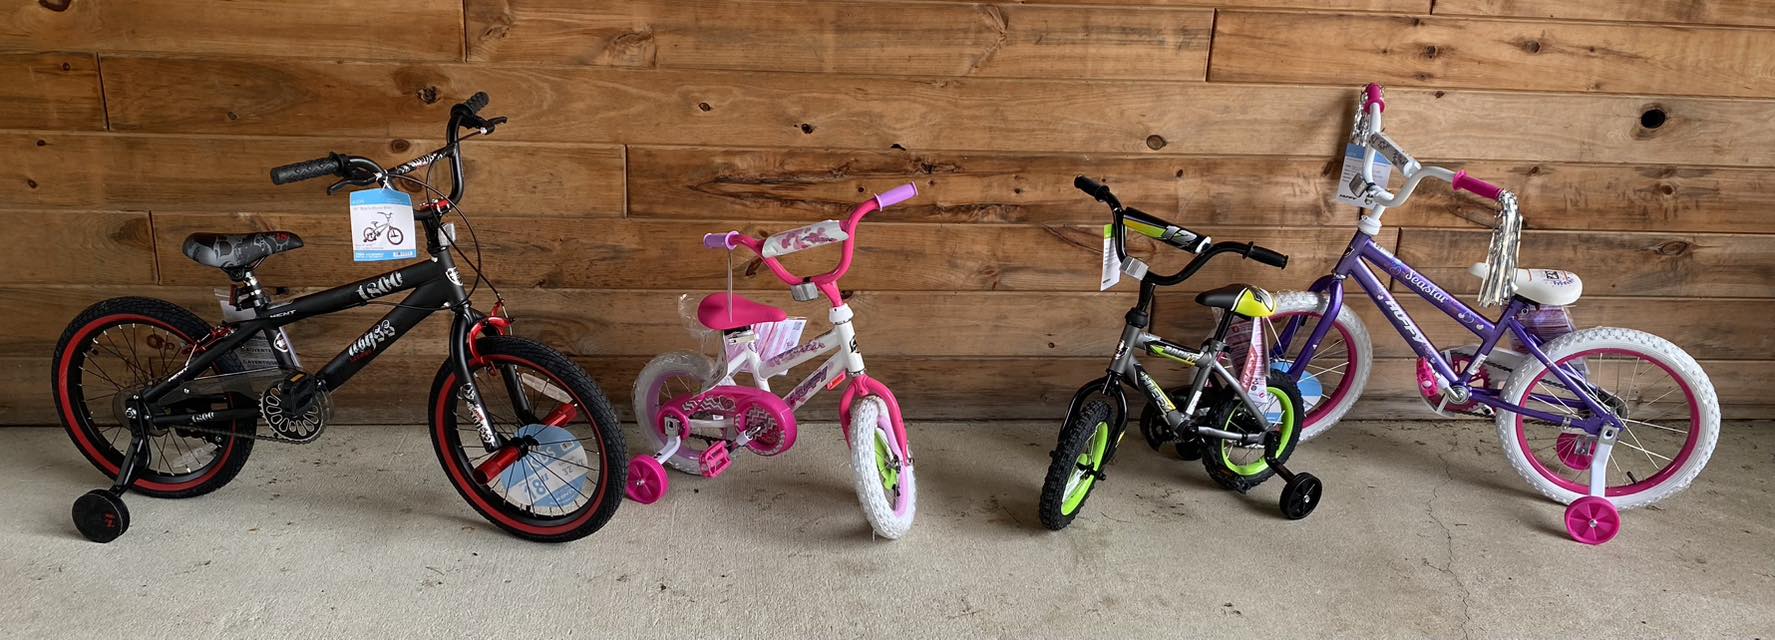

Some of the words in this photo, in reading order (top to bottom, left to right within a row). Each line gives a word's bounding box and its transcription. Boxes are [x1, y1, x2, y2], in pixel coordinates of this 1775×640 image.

[1405, 271, 1447, 304] Seastar
[269, 309, 297, 318] KENT
[1385, 300, 1426, 343] HUFFY
